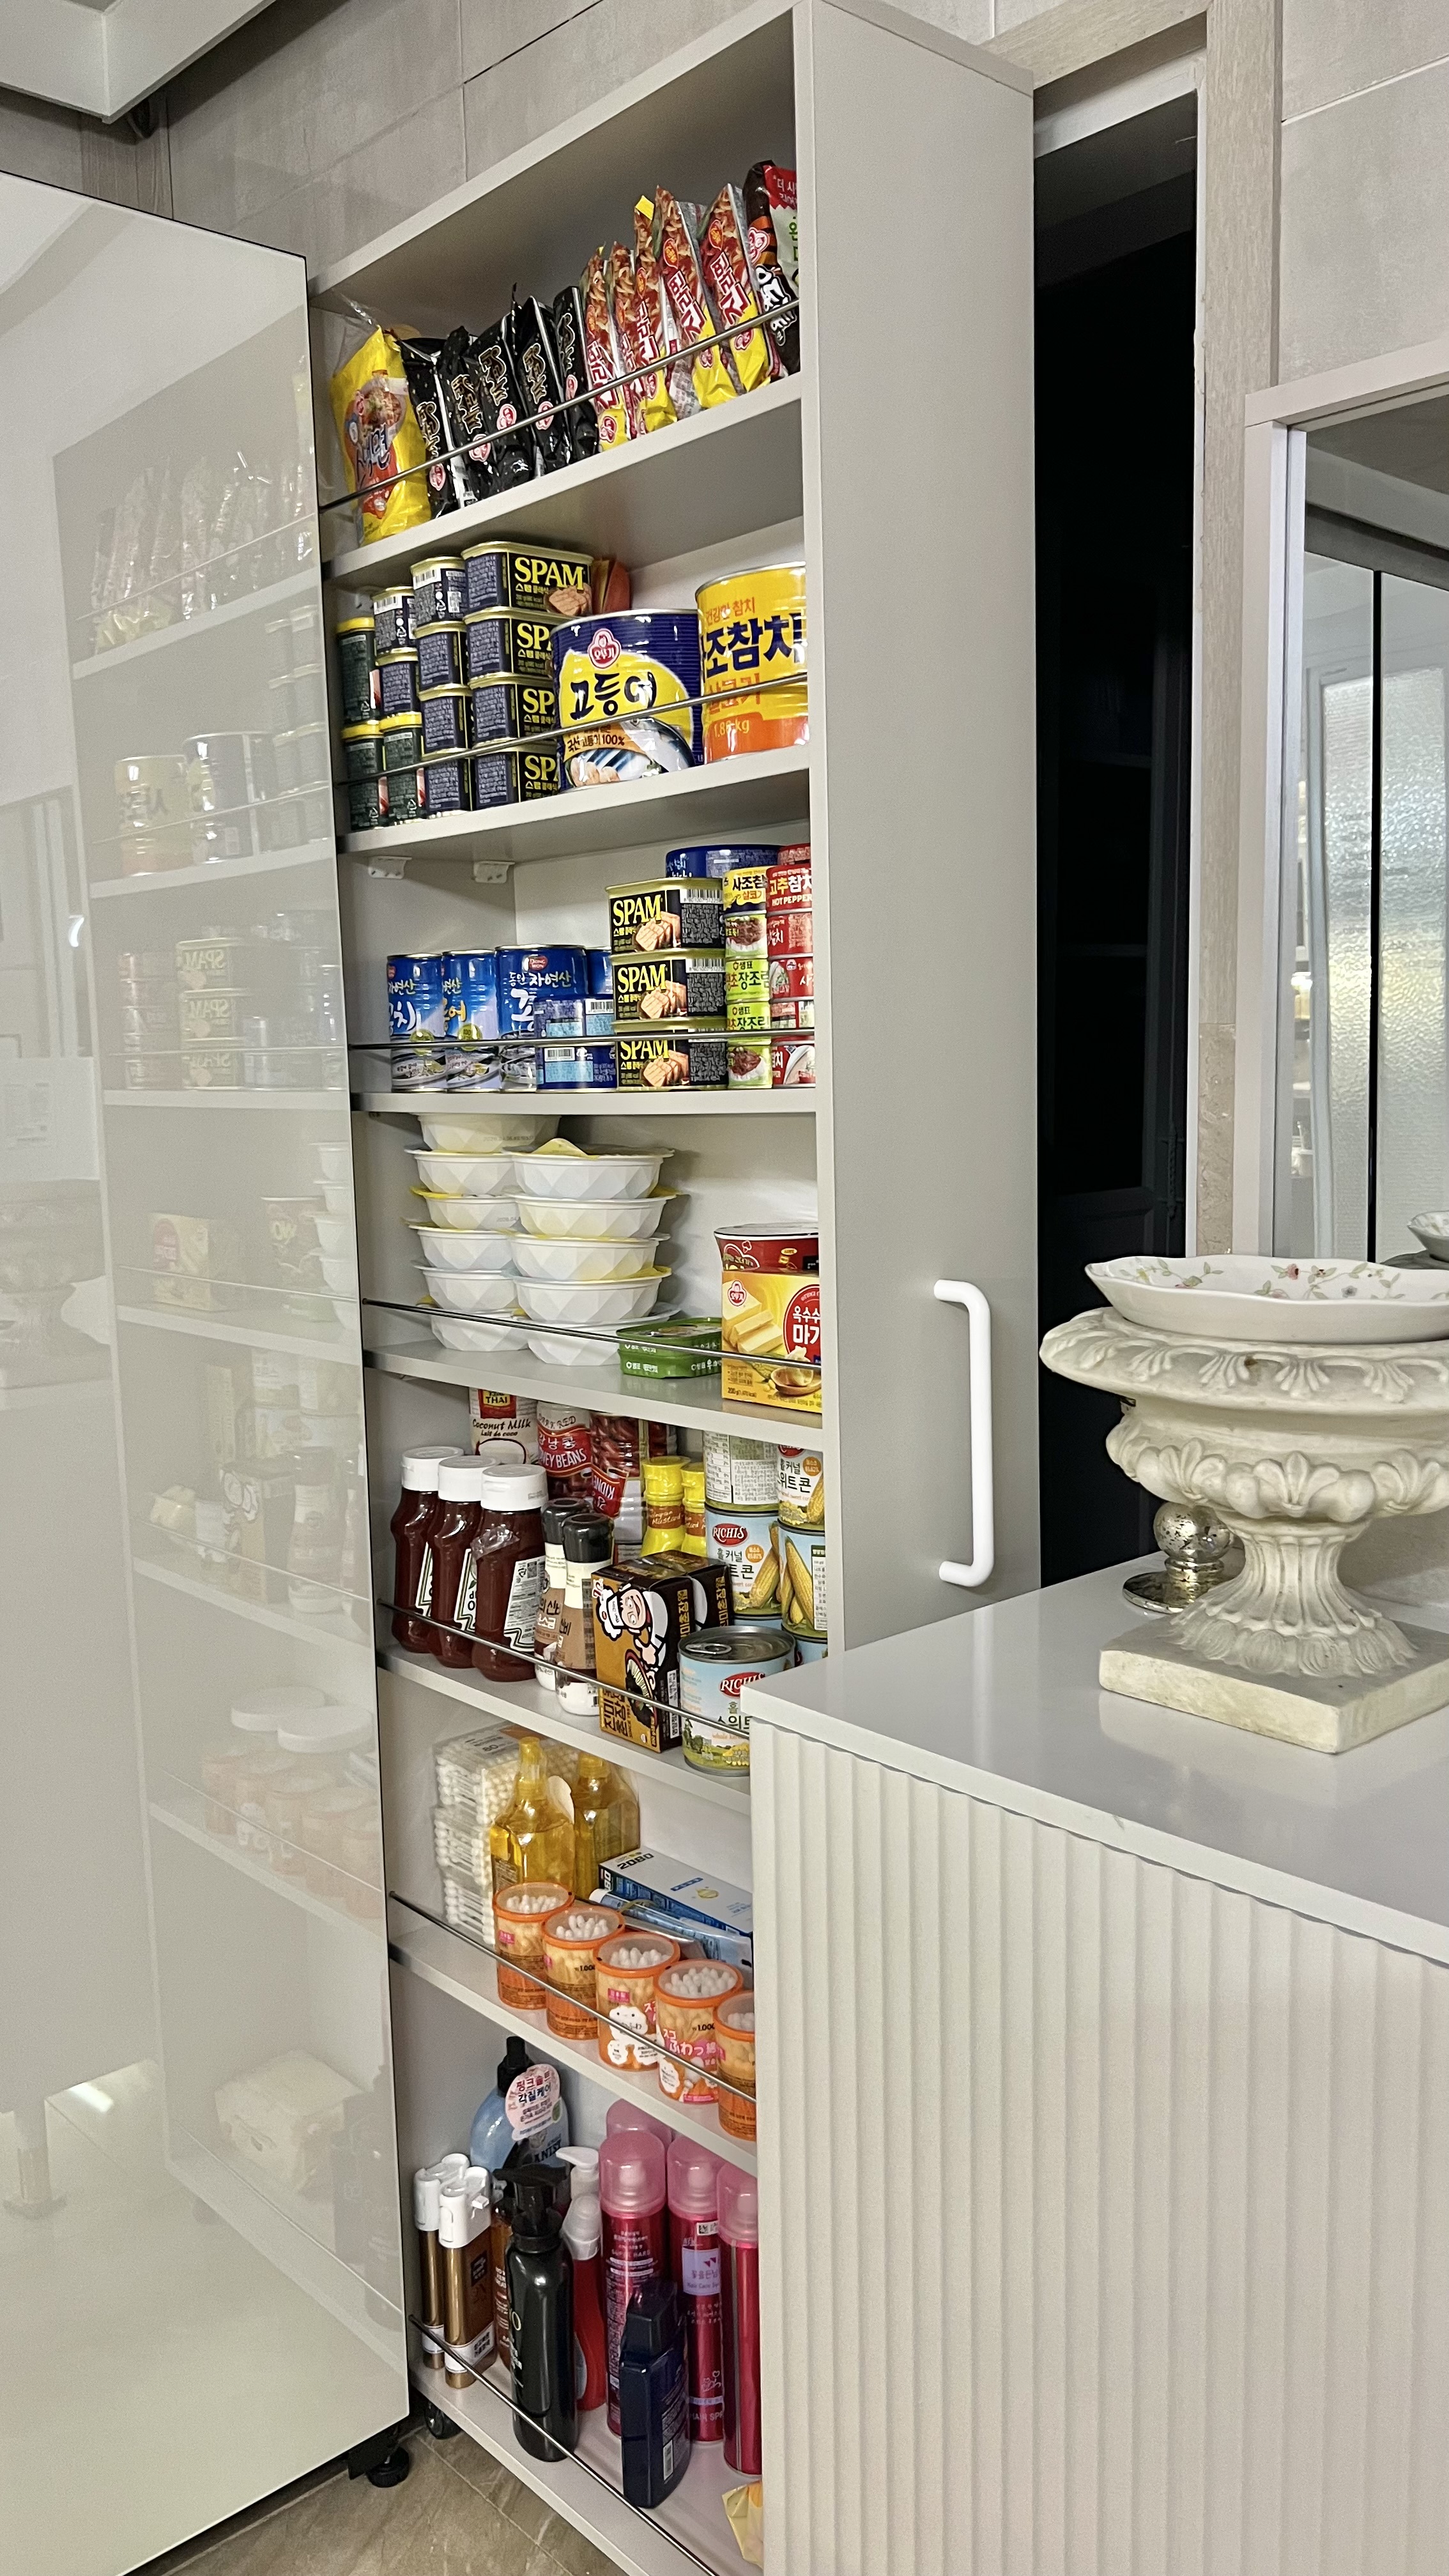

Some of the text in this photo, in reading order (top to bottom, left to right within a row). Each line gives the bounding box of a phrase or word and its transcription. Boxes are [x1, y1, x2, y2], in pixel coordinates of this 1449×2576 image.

[710, 251, 751, 326] 진라면
[668, 270, 707, 342] 진라면
[514, 557, 584, 590] SPAM
[705, 597, 756, 627] 건강한 참치
[594, 648, 615, 661] 오뚜기
[569, 671, 657, 721] 고등어
[602, 733, 625, 747] 100%
[612, 894, 661, 926] SPAM
[509, 970, 572, 988] 동원 자연산
[617, 963, 666, 993] SPAM
[620, 1039, 670, 1061] SPAM
[485, 1395, 508, 1404] THAI
[472, 1418, 505, 1430] Coconut
[556, 1414, 577, 1427] RED
[556, 1448, 587, 1468] BEANS
[785, 1461, 801, 1475] 커널
[712, 1525, 746, 1543] RICHIS
[725, 1549, 742, 1563] 커널
[604, 1699, 615, 1728] 진미
[615, 1703, 629, 1737] 춘장
[617, 1853, 654, 1870] 2080
[518, 2082, 552, 2104] 각질케어
